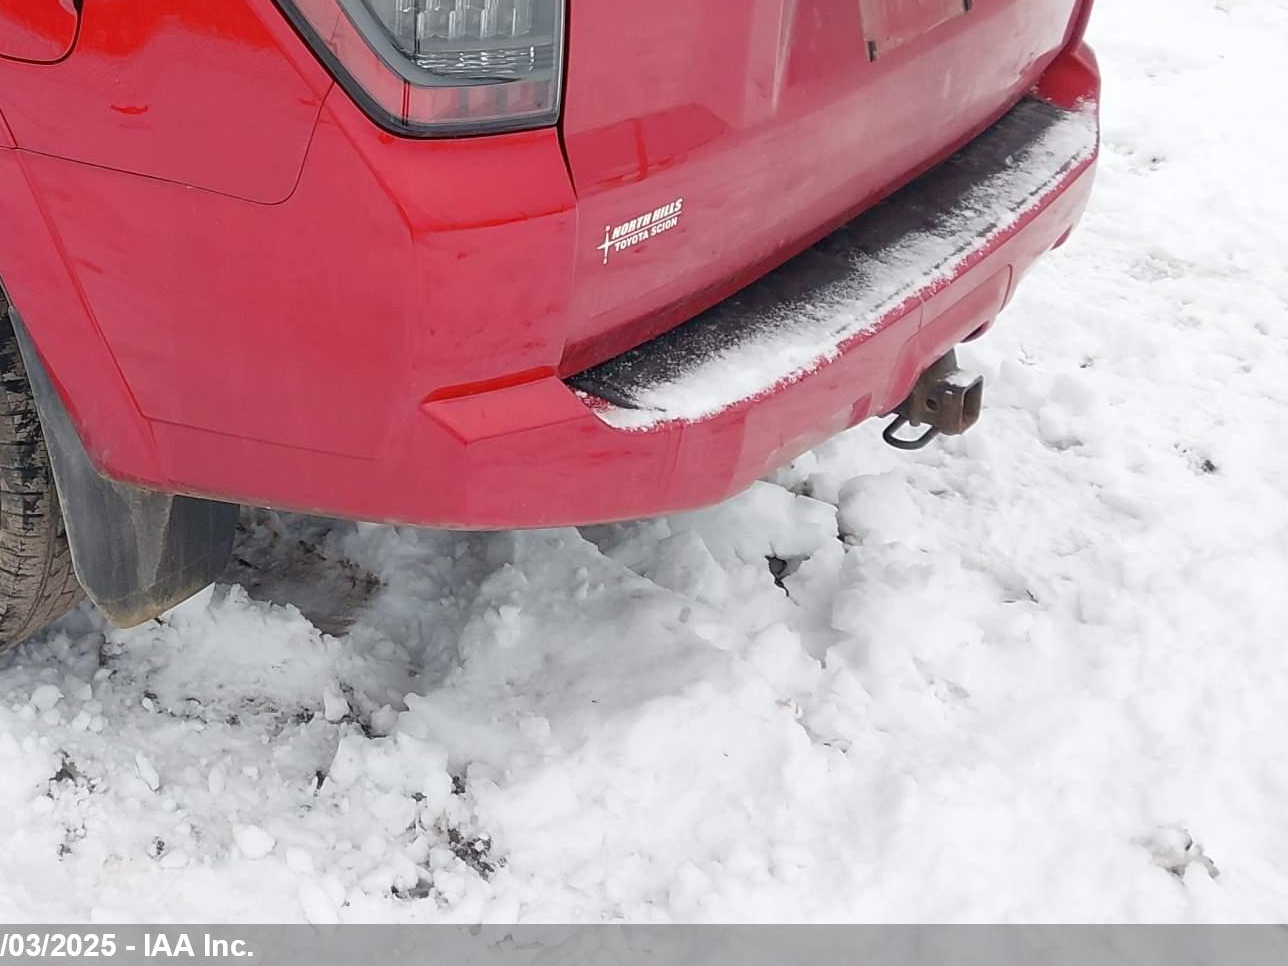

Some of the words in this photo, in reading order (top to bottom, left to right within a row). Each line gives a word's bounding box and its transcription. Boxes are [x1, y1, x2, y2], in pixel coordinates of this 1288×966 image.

[612, 212, 653, 240] NORTH
[652, 198, 683, 223] HILLS
[615, 230, 649, 252] TOYOTA
[650, 216, 678, 237] SCION
